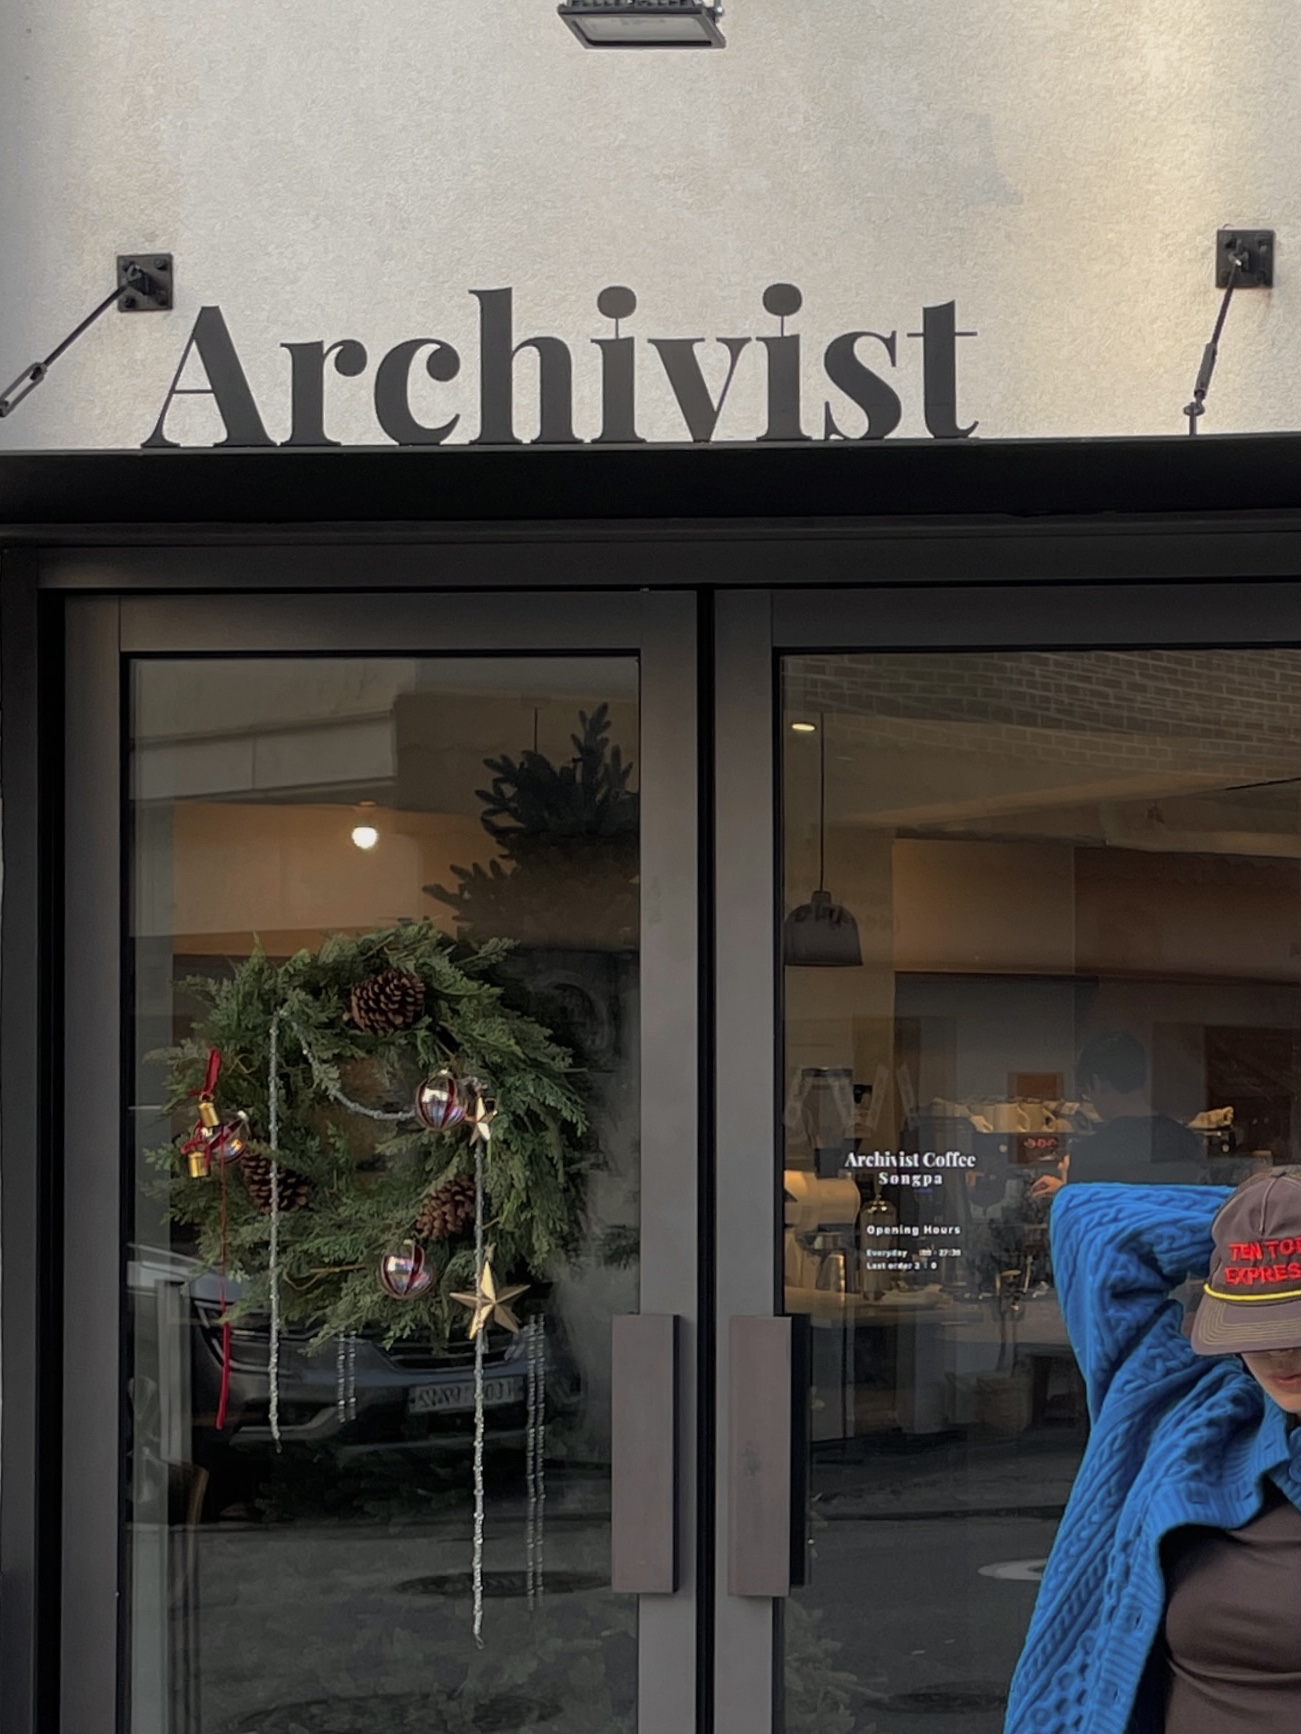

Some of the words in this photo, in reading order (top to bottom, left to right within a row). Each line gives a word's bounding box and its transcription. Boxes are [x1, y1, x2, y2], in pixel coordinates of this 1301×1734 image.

[140, 283, 980, 446] Archivist
[845, 1151, 919, 1168] Archivist
[922, 1151, 976, 1168] Coffee
[878, 1171, 943, 1187] Songpa
[866, 1225, 920, 1236] Opening
[923, 1225, 961, 1235] Hours
[1228, 1241, 1263, 1262] TEN
[866, 1262, 886, 1270] Last
